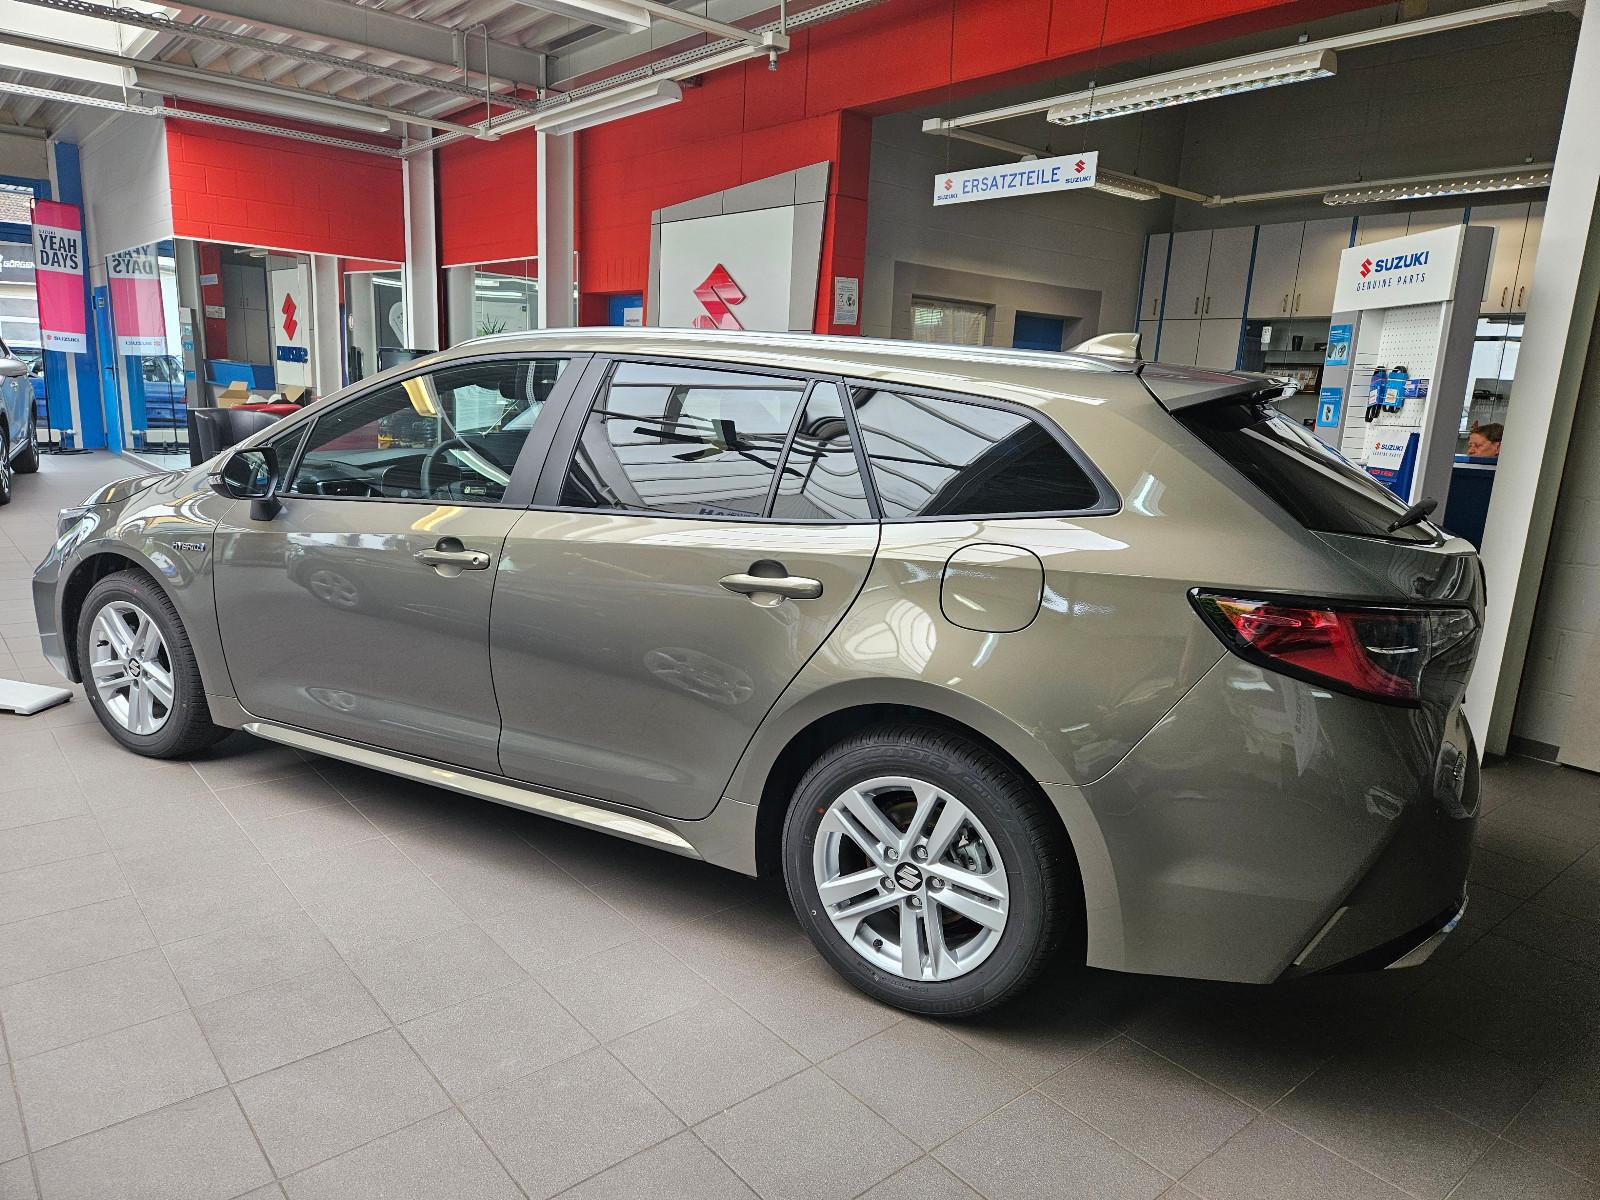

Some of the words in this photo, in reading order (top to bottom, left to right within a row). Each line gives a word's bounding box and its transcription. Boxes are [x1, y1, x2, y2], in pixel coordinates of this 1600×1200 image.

[962, 166, 1061, 195] ERSATZTEILE
[1065, 175, 1092, 184] SUZUKI
[937, 193, 958, 201] SUZUKI
[39, 233, 77, 254] YEAH
[40, 250, 79, 270] DAYS
[1374, 251, 1430, 273] SUZUKI
[1356, 277, 1393, 292] GENUINE
[1396, 272, 1426, 286] PARTS
[53, 335, 80, 343] SUZUKI
[1381, 443, 1404, 452] SUZUKI
